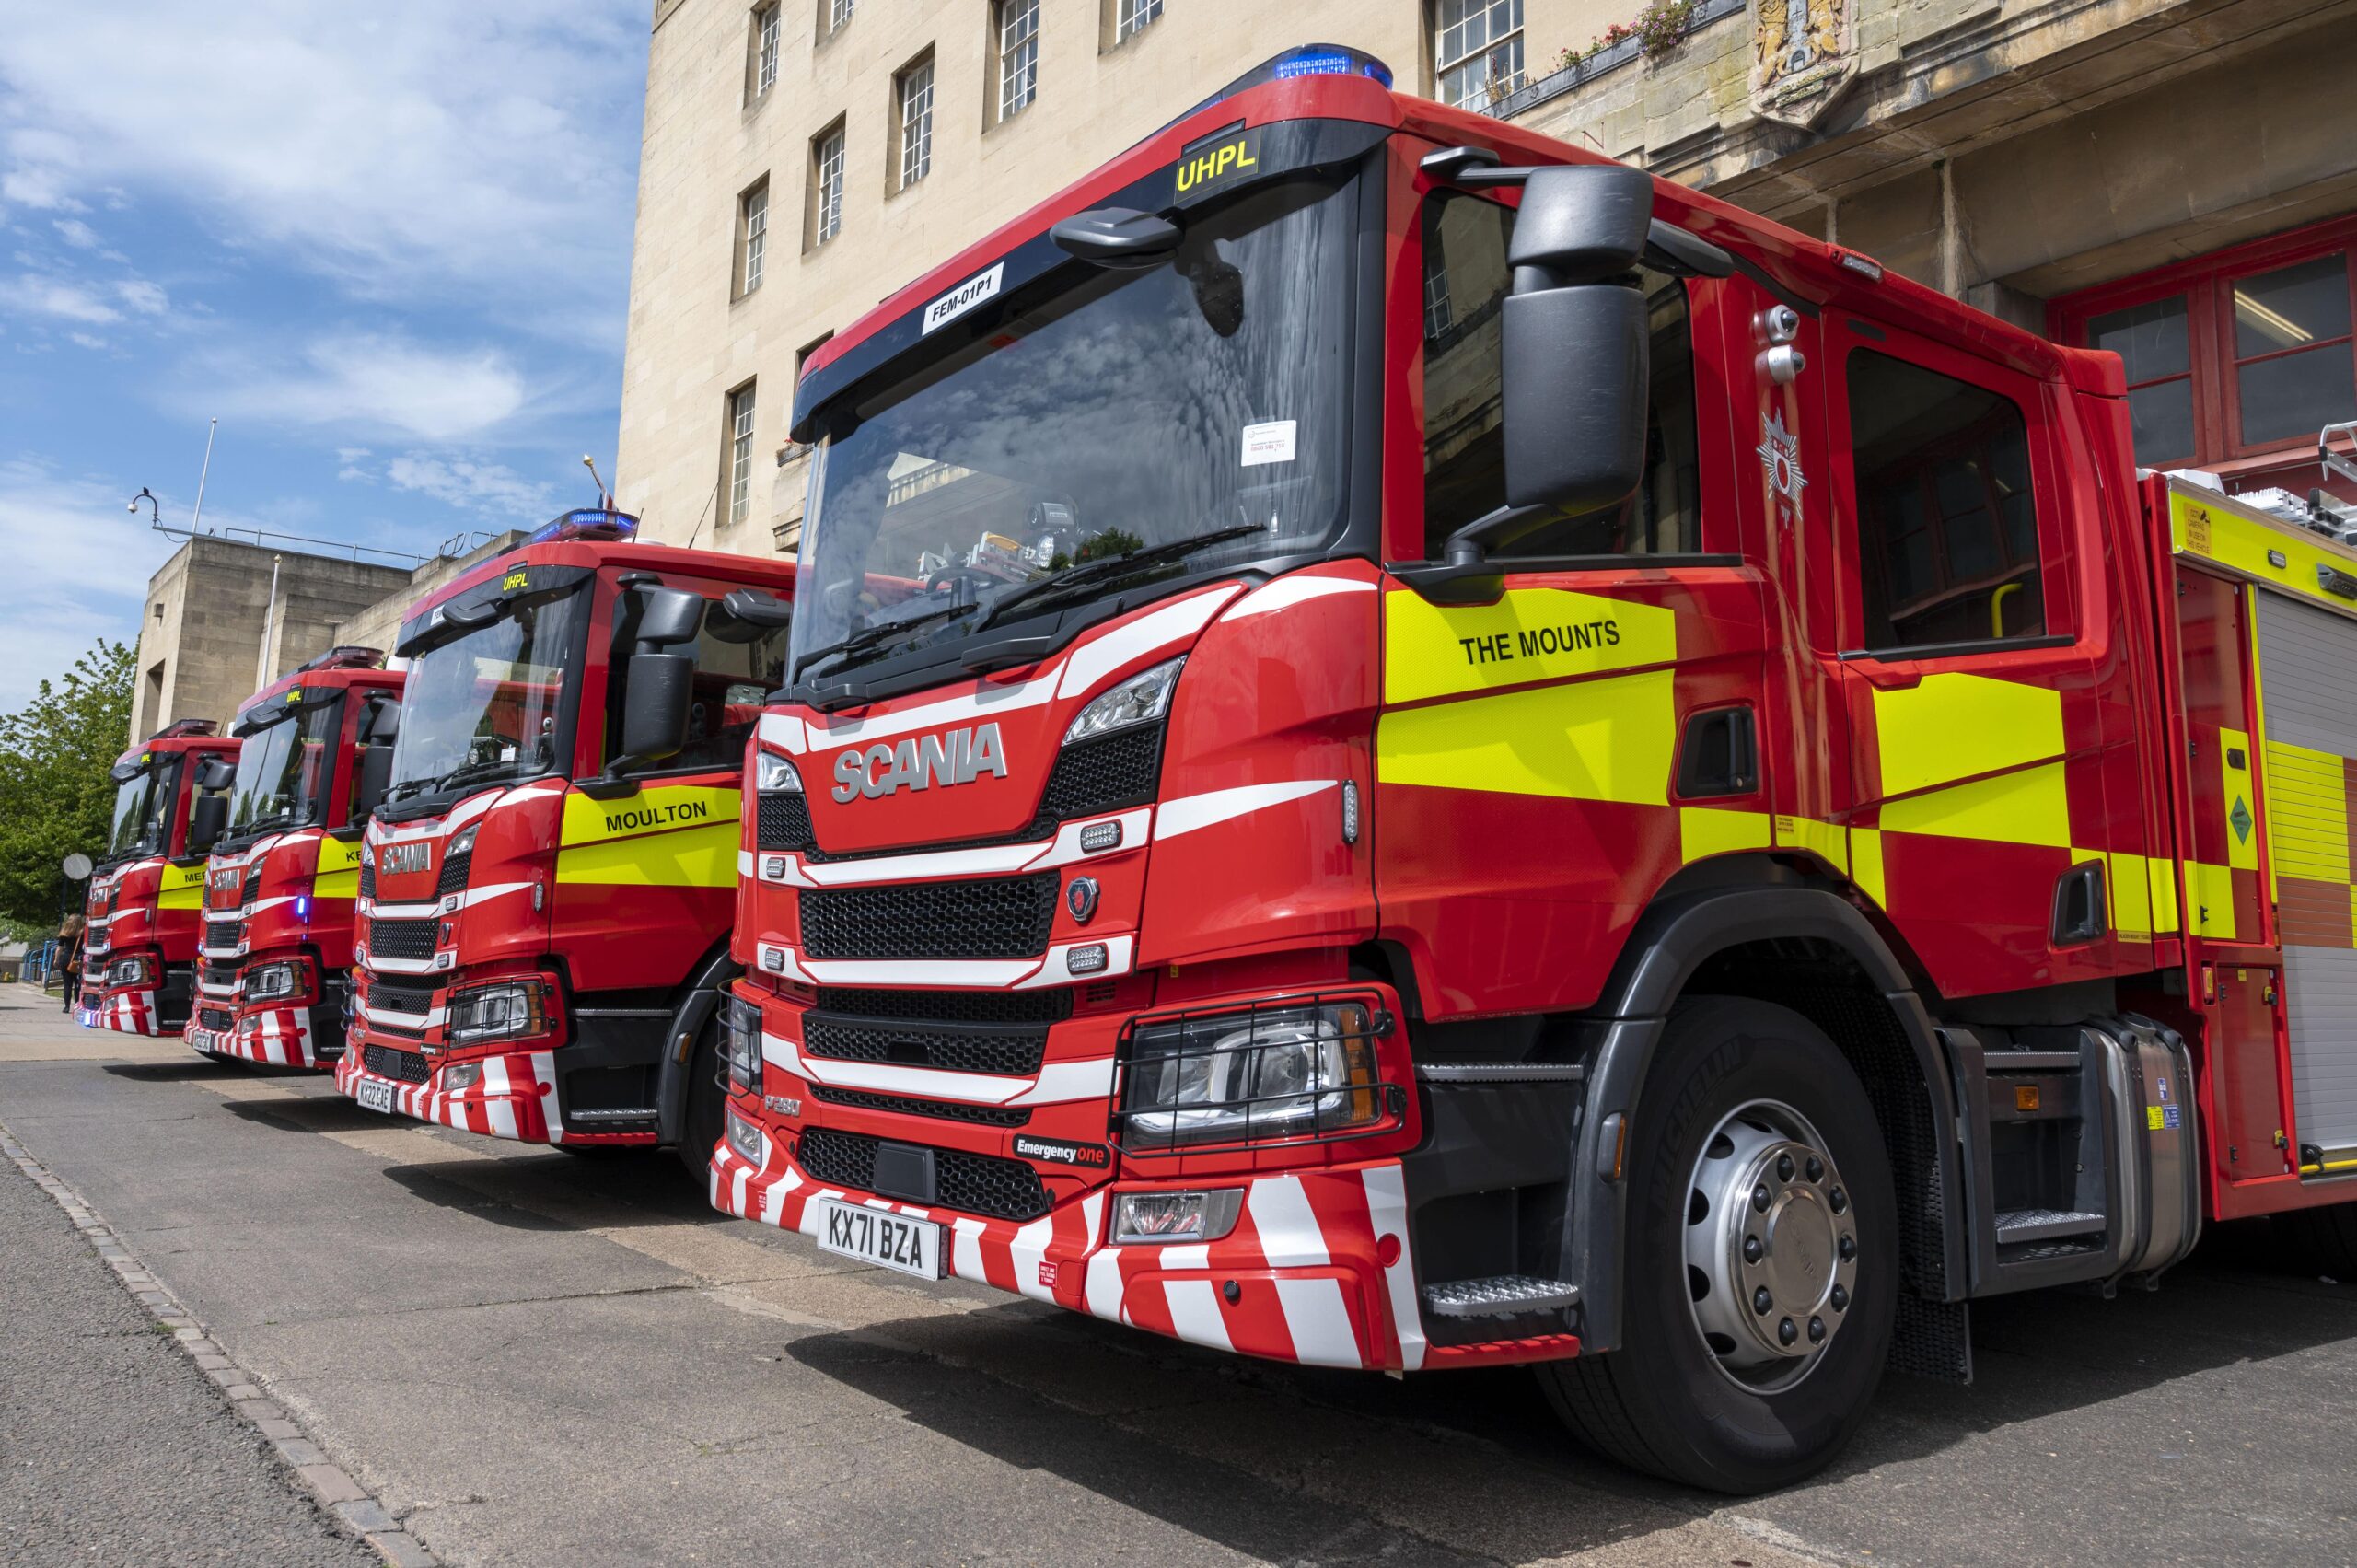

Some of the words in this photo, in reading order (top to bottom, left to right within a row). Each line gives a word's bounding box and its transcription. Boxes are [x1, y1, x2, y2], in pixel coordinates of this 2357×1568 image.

[1178, 141, 1256, 192] UHPL
[932, 275, 992, 322] FEM-01P1
[504, 573, 528, 590] UHPL
[1459, 633, 1514, 665] THE
[1518, 620, 1620, 657] MOUNTS
[831, 722, 1008, 804] SCANIA
[606, 801, 707, 831] MOULTON
[381, 842, 432, 875] SCANIA
[829, 1207, 875, 1255] KX71
[879, 1219, 923, 1269] BZA
